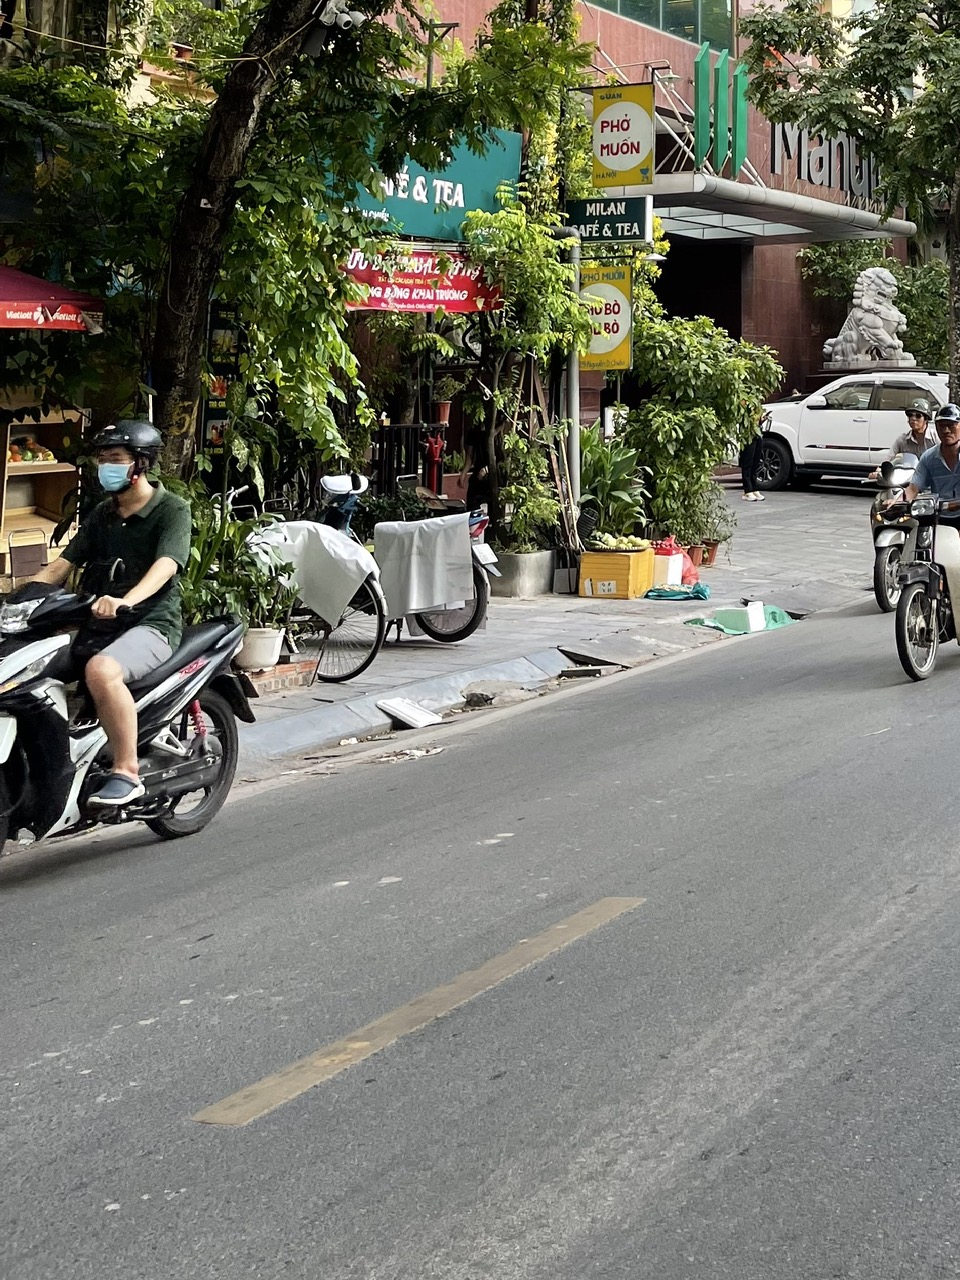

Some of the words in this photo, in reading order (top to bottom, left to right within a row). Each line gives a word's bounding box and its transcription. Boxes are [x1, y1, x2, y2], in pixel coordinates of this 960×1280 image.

[600, 113, 631, 133] PHỞ
[600, 136, 640, 157] MUỐN
[413, 175, 429, 204] &
[433, 179, 465, 207] TEA
[585, 201, 626, 216] MILAN
[602, 223, 613, 237] &
[615, 222, 640, 236] TEA
[368, 286, 382, 299] NG
[411, 288, 434, 301] KHAI
[604, 299, 621, 316] BÒ
[603, 318, 620, 335] BÒ
